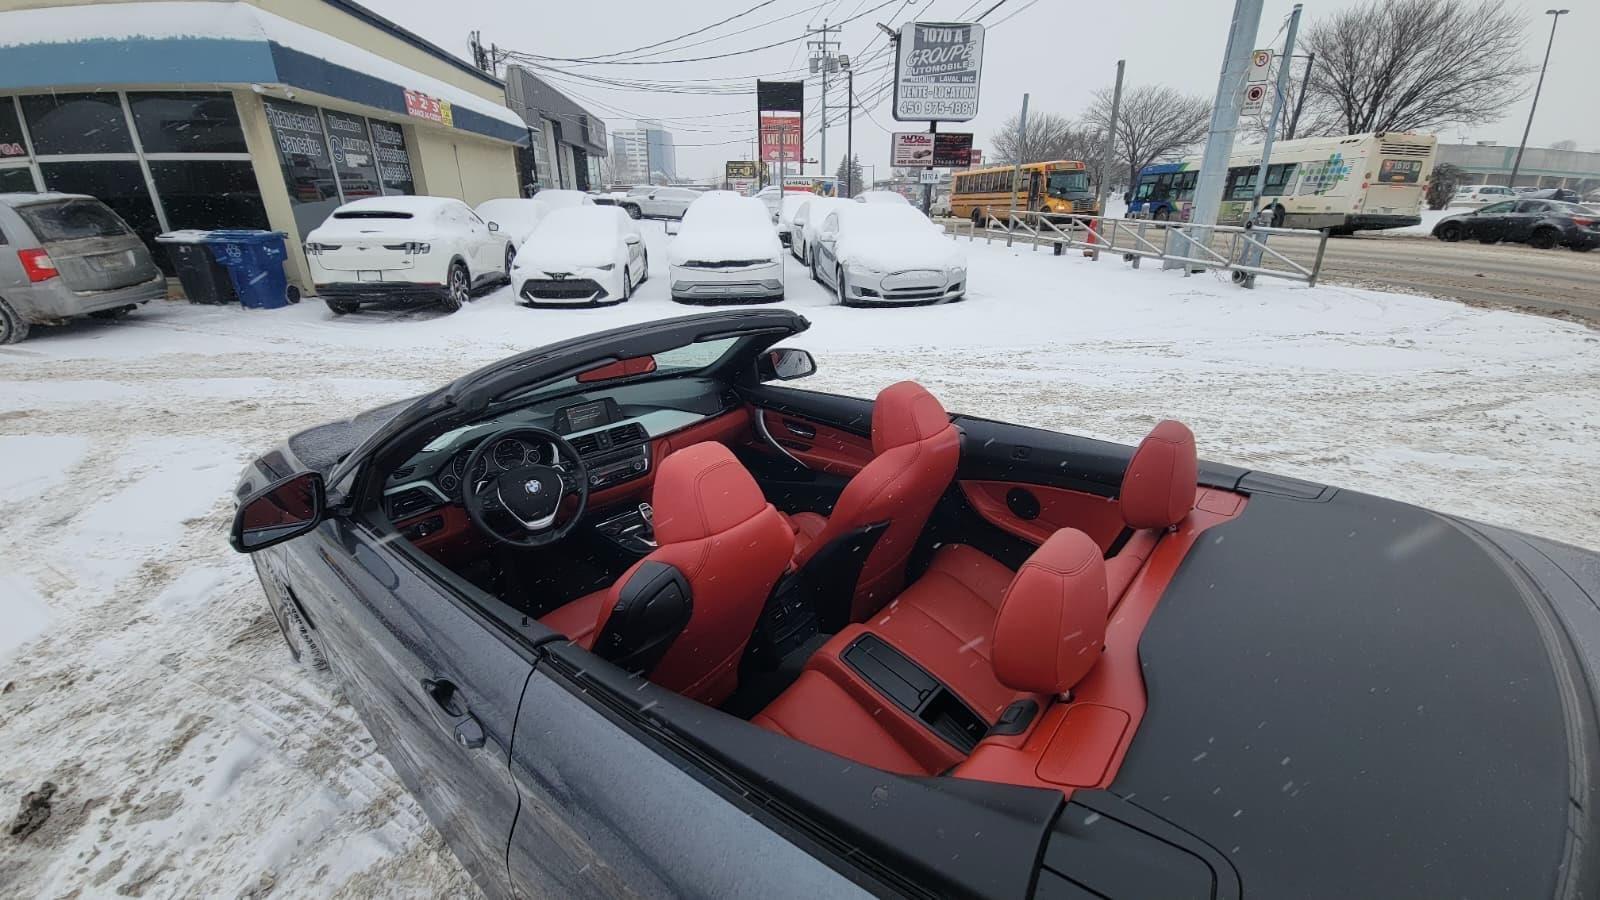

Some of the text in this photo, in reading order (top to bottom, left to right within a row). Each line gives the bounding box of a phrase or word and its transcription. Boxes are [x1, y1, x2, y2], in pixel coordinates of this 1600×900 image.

[922, 28, 964, 43] 1070 A
[906, 40, 977, 68] GROUPE
[905, 60, 976, 76] AUTOMOBILES
[940, 75, 960, 83] LAVAL
[900, 101, 977, 115] 450 975-1881
[277, 129, 321, 156] Bancaire
